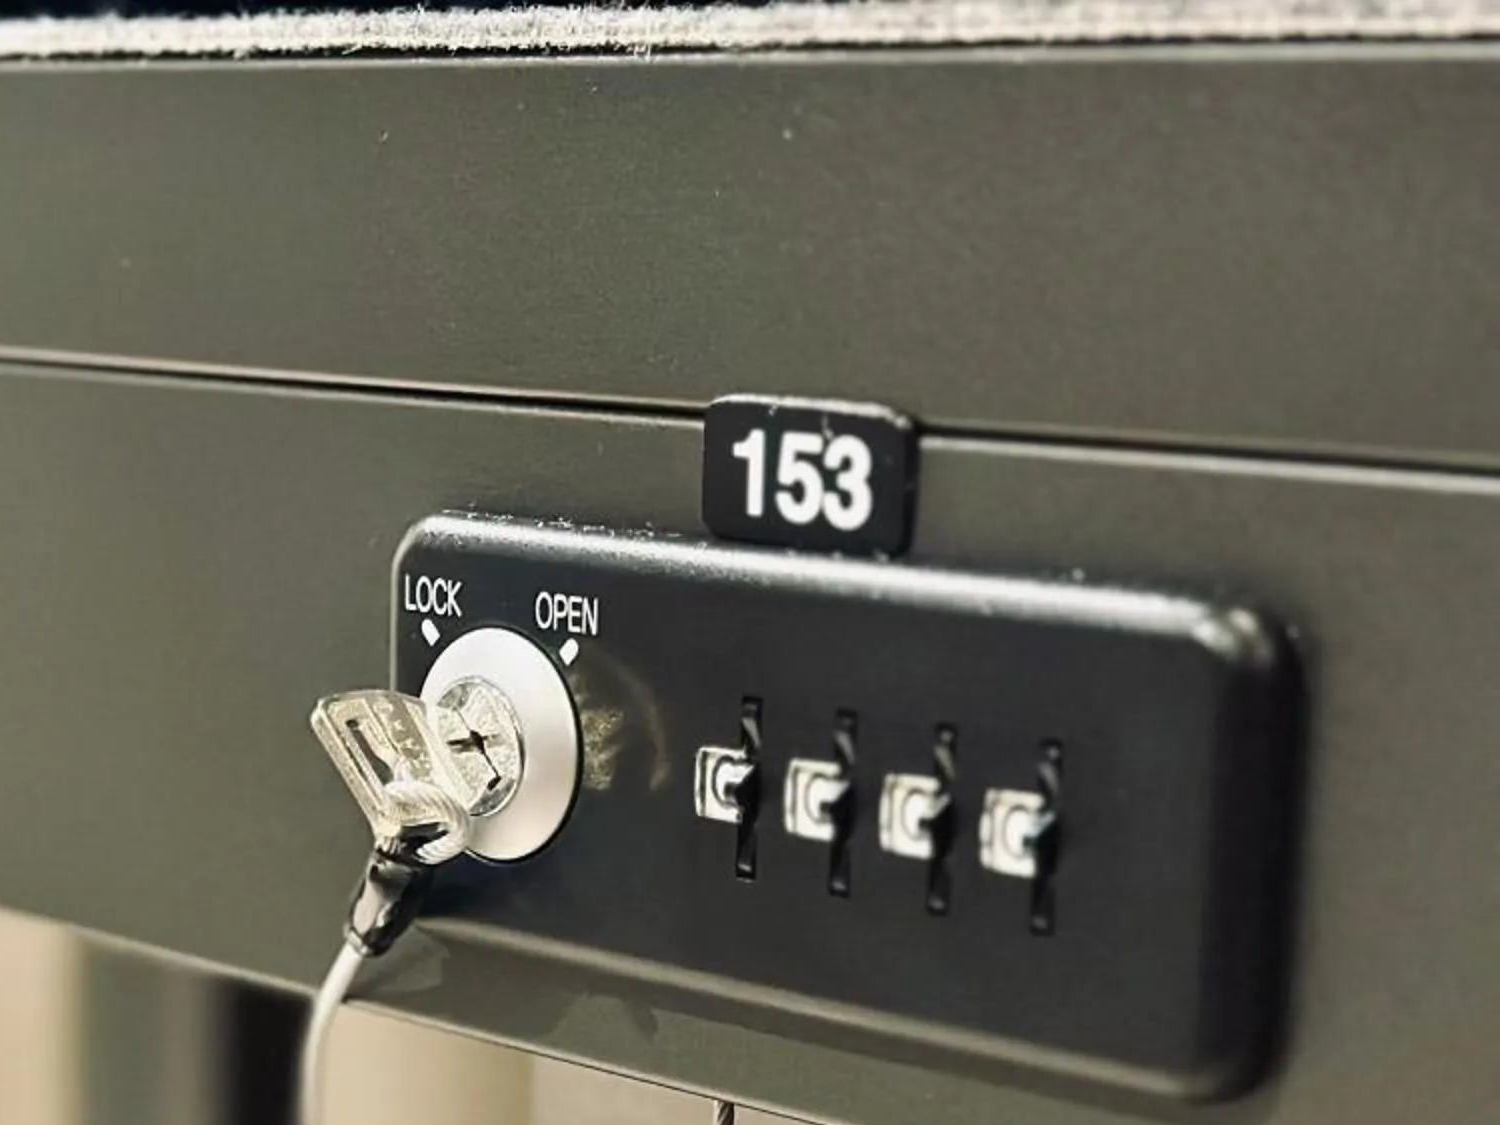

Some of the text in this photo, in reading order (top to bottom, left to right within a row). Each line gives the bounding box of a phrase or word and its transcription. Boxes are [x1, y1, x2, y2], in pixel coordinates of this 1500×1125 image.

[732, 428, 873, 531] 153
[404, 574, 463, 618] LOCK
[535, 591, 598, 636] OPEN
